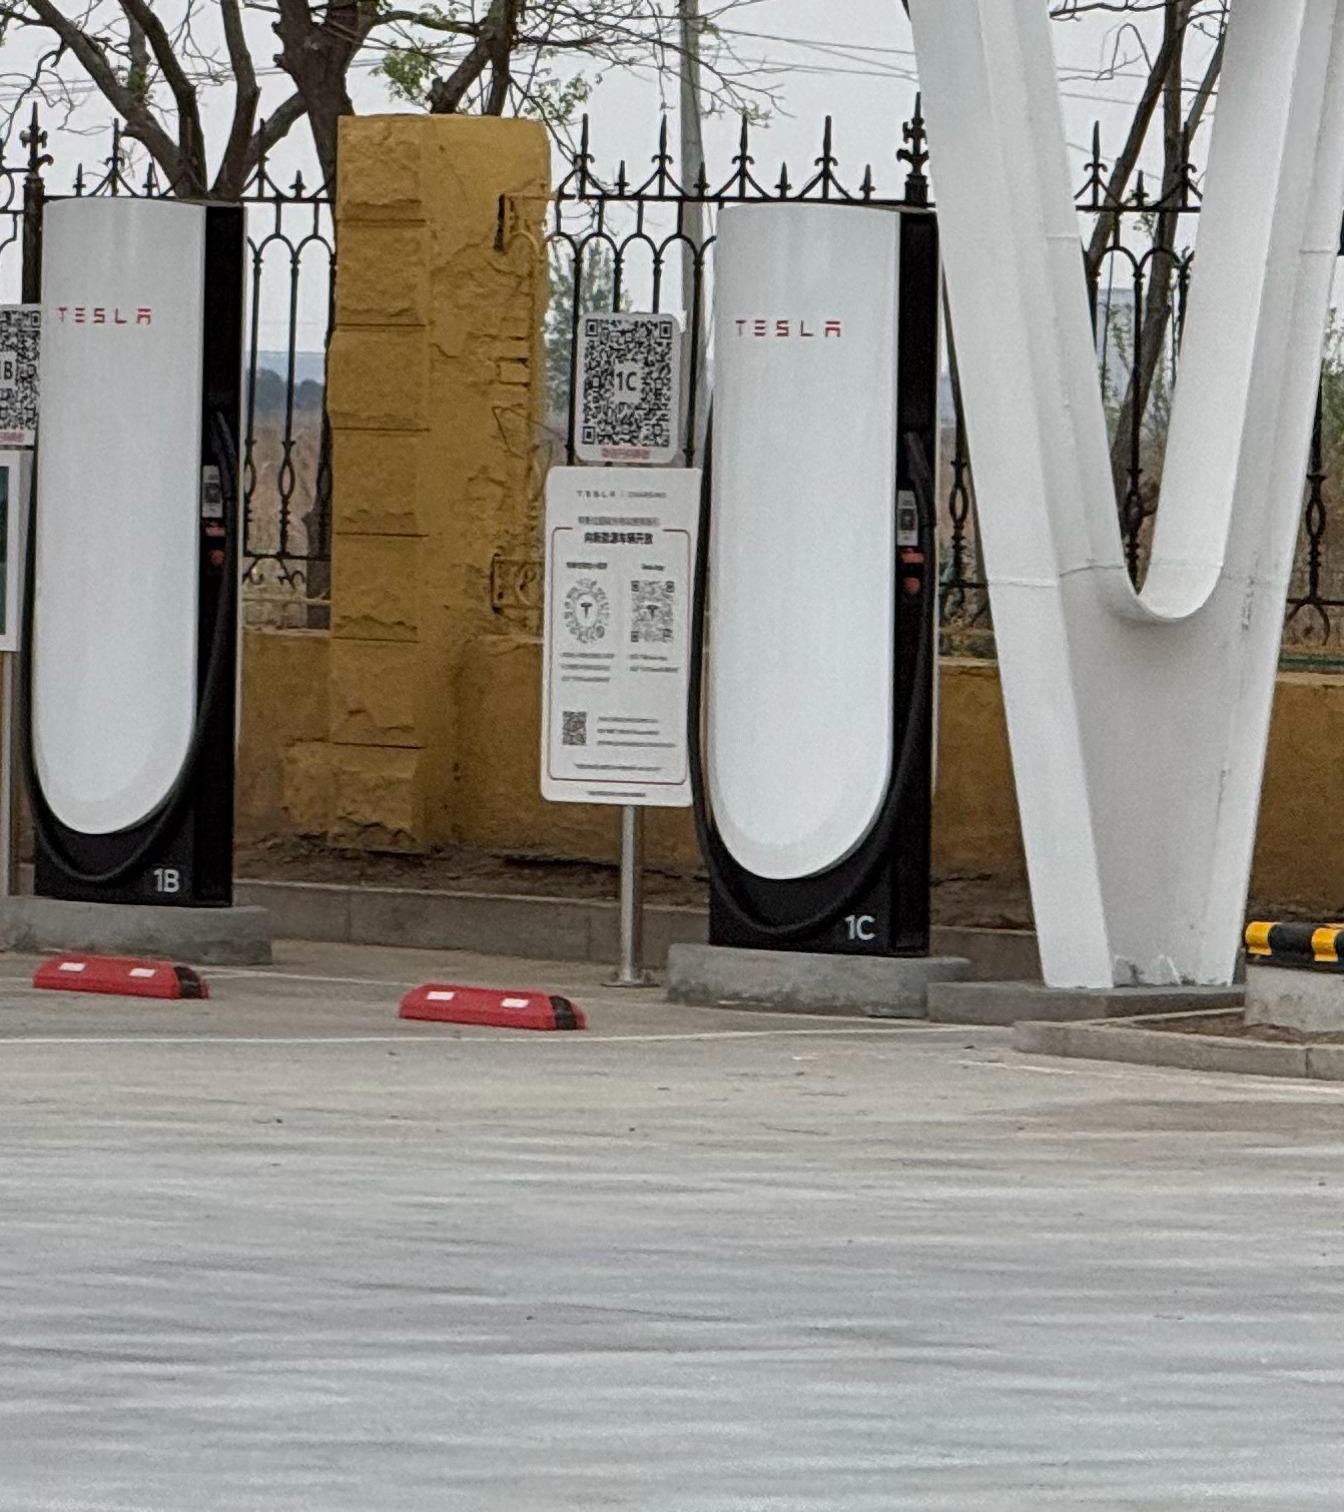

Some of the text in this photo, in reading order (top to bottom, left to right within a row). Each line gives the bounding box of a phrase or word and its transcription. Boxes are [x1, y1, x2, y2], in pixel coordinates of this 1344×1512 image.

[58, 307, 151, 324] TESLA
[735, 320, 840, 337] TESLA
[616, 371, 637, 391] 1C
[153, 868, 180, 893] 1B
[845, 914, 876, 941] 1C
